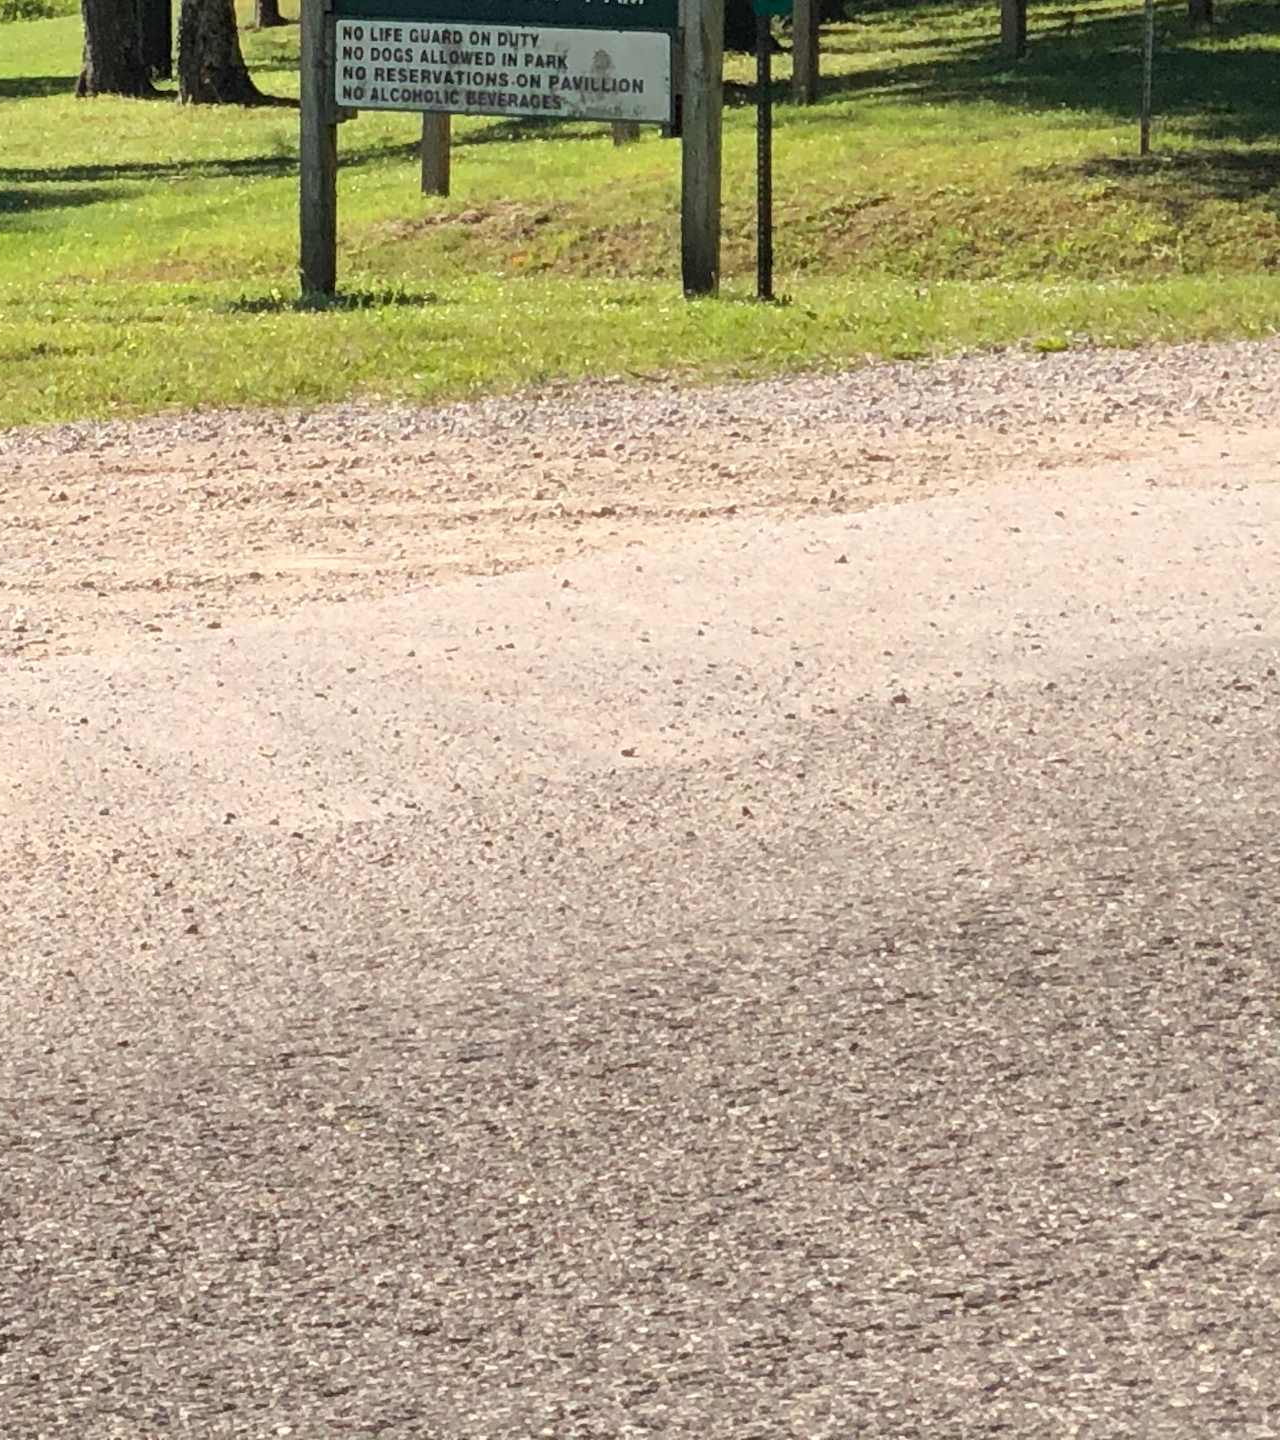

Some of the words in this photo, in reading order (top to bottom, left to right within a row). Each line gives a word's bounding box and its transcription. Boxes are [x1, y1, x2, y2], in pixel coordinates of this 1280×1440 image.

[342, 26, 364, 42] NO
[370, 27, 403, 43] LIFE
[409, 29, 463, 45] GUARD
[469, 31, 491, 47] ON
[497, 32, 540, 48] DUTY
[342, 46, 364, 61] NO
[370, 47, 414, 63] DOGS
[420, 49, 496, 66] ALLOWED
[502, 52, 518, 67] IN
[524, 54, 569, 70] PARK
[342, 66, 367, 81] NO
[374, 67, 509, 88] RESERVATIONS
[516, 73, 541, 89] ON
[548, 75, 644, 94] PAVILLION
[342, 86, 365, 101] NO
[370, 87, 460, 105] ALCOHOLIC
[465, 90, 563, 110] BEVERAGES
